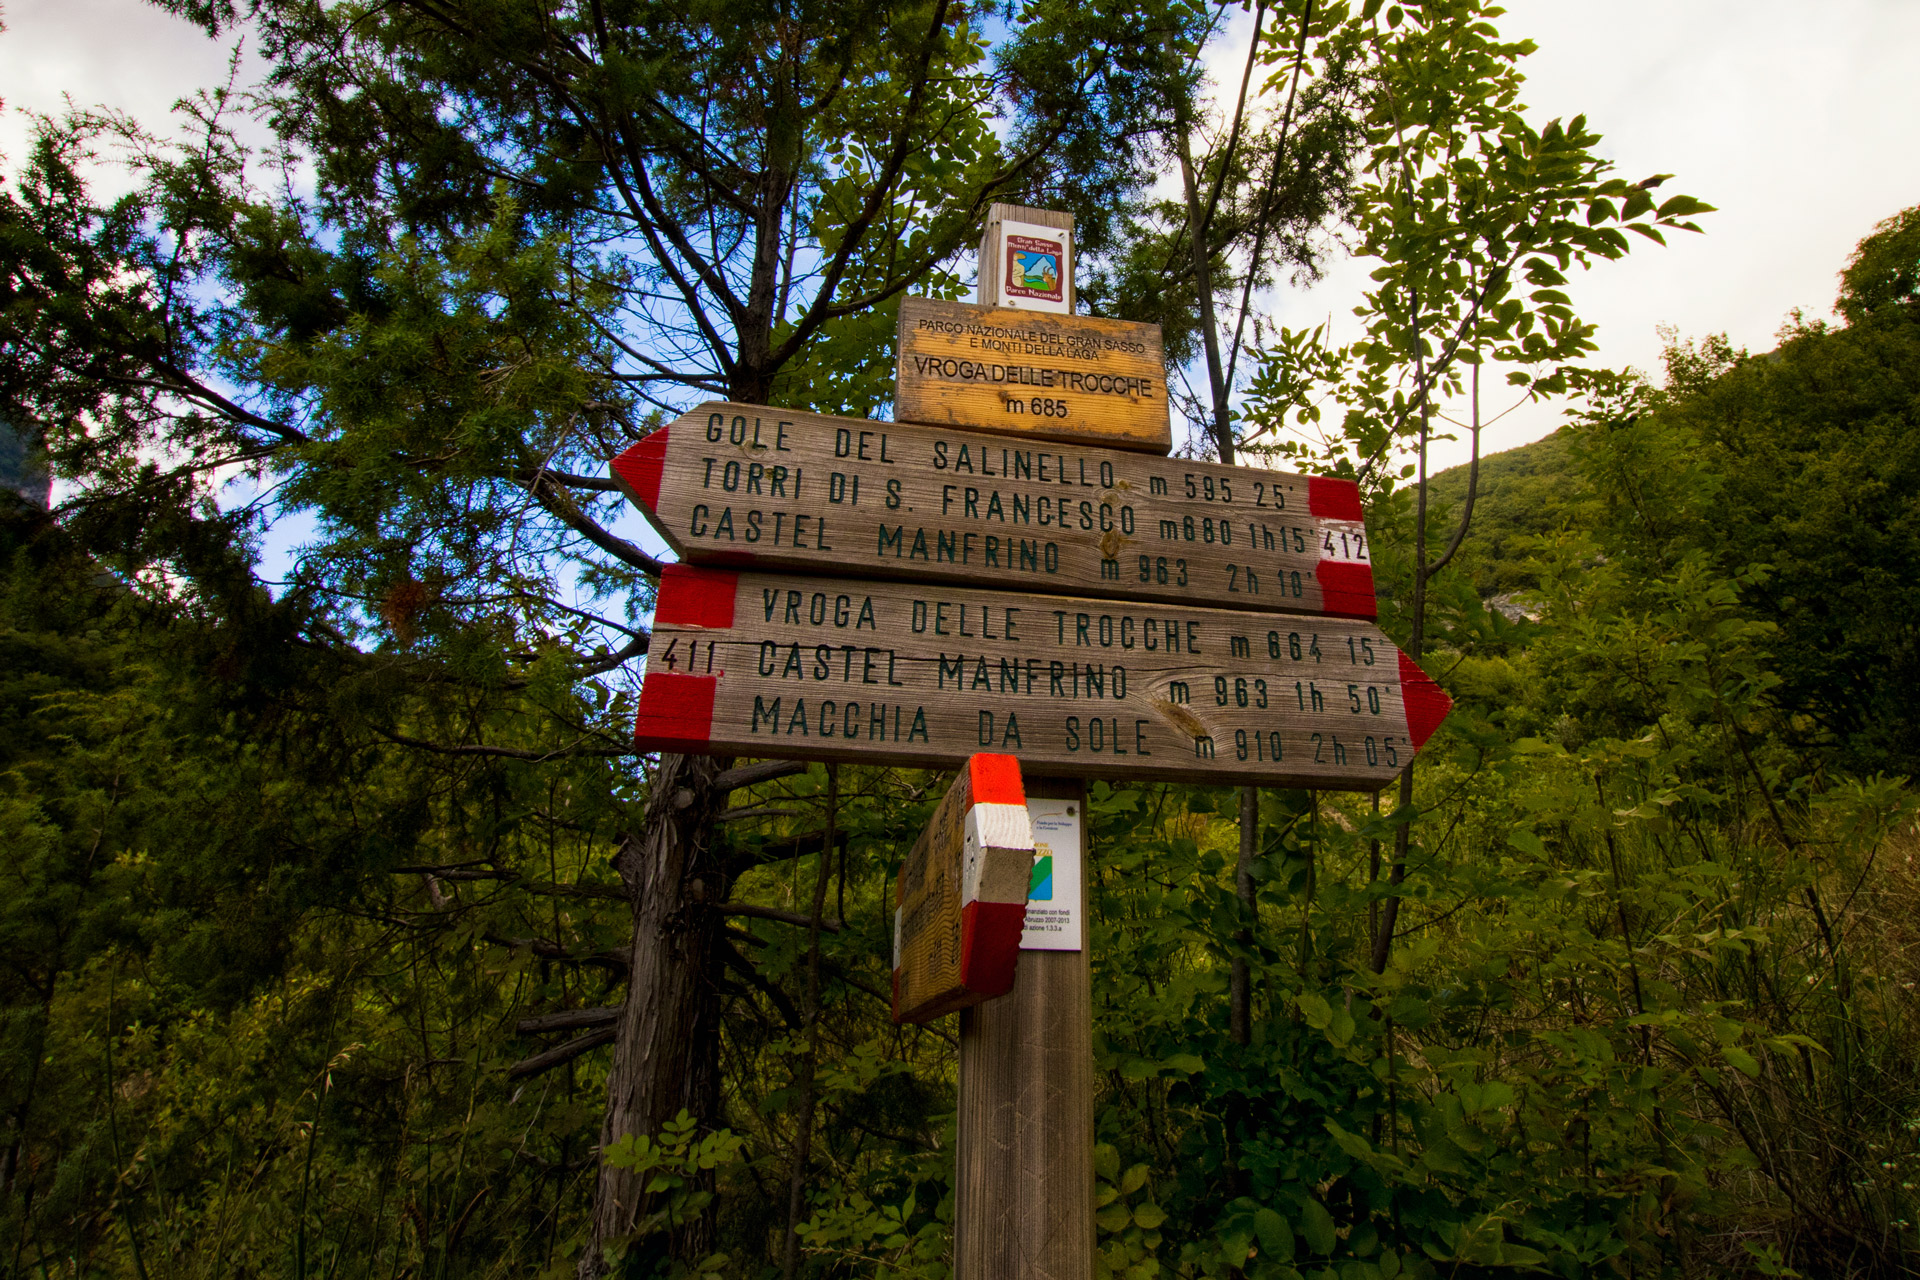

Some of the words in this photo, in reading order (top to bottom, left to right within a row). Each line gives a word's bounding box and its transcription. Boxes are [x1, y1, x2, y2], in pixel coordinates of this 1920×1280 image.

[1006, 286, 1026, 294] Parco
[1028, 289, 1061, 300] Nazionale
[919, 319, 964, 334] PARCO
[966, 324, 1036, 343] NAZIONALE
[1040, 333, 1064, 345] DEL
[1066, 335, 1101, 350] GRAN
[1104, 339, 1145, 354] SASSO
[970, 337, 978, 348] E
[981, 339, 1022, 354] MONTI
[1025, 343, 1063, 358] DELLA
[1066, 347, 1099, 361] LAGA
[914, 356, 988, 381] VROGA
[992, 364, 1054, 388] DELLE
[1060, 370, 1153, 398] TROCCHE
[1006, 399, 1024, 414] m
[1030, 397, 1068, 419] 685
[706, 412, 794, 452] GOLE
[835, 428, 894, 464] DEL
[933, 441, 1114, 490] SALINELLO
[1150, 475, 1168, 496] m
[1184, 473, 1232, 503] 595
[702, 457, 802, 499] TORRI
[829, 472, 859, 506] DI
[885, 478, 914, 512] S.
[942, 484, 1135, 535] FRANCESCO
[690, 504, 832, 551] CASTEL
[877, 523, 1059, 574] MANFRINO
[1100, 558, 1120, 581] m
[1138, 555, 1188, 587] 963
[1225, 563, 1259, 595] 2h
[1323, 530, 1368, 560] 412
[763, 588, 876, 631] VROGA
[911, 600, 1021, 642] DELLE
[1053, 610, 1202, 655] TROCCHE
[1230, 635, 1251, 658] m
[1267, 630, 1322, 664] 664
[661, 638, 715, 674] 411
[758, 640, 903, 686] CASTEL
[938, 652, 1127, 700] MANFRINO
[1169, 680, 1190, 704] m
[1214, 676, 1268, 709] 963
[1295, 681, 1324, 712] 1h
[751, 695, 929, 743] MACCHIA
[978, 709, 1023, 749] DA
[1065, 715, 1151, 756] SOLE
[1195, 735, 1216, 759] m
[1235, 728, 1283, 762] 910
[1310, 732, 1347, 766] 2h
[1045, 916, 1070, 924] 2007-2013
